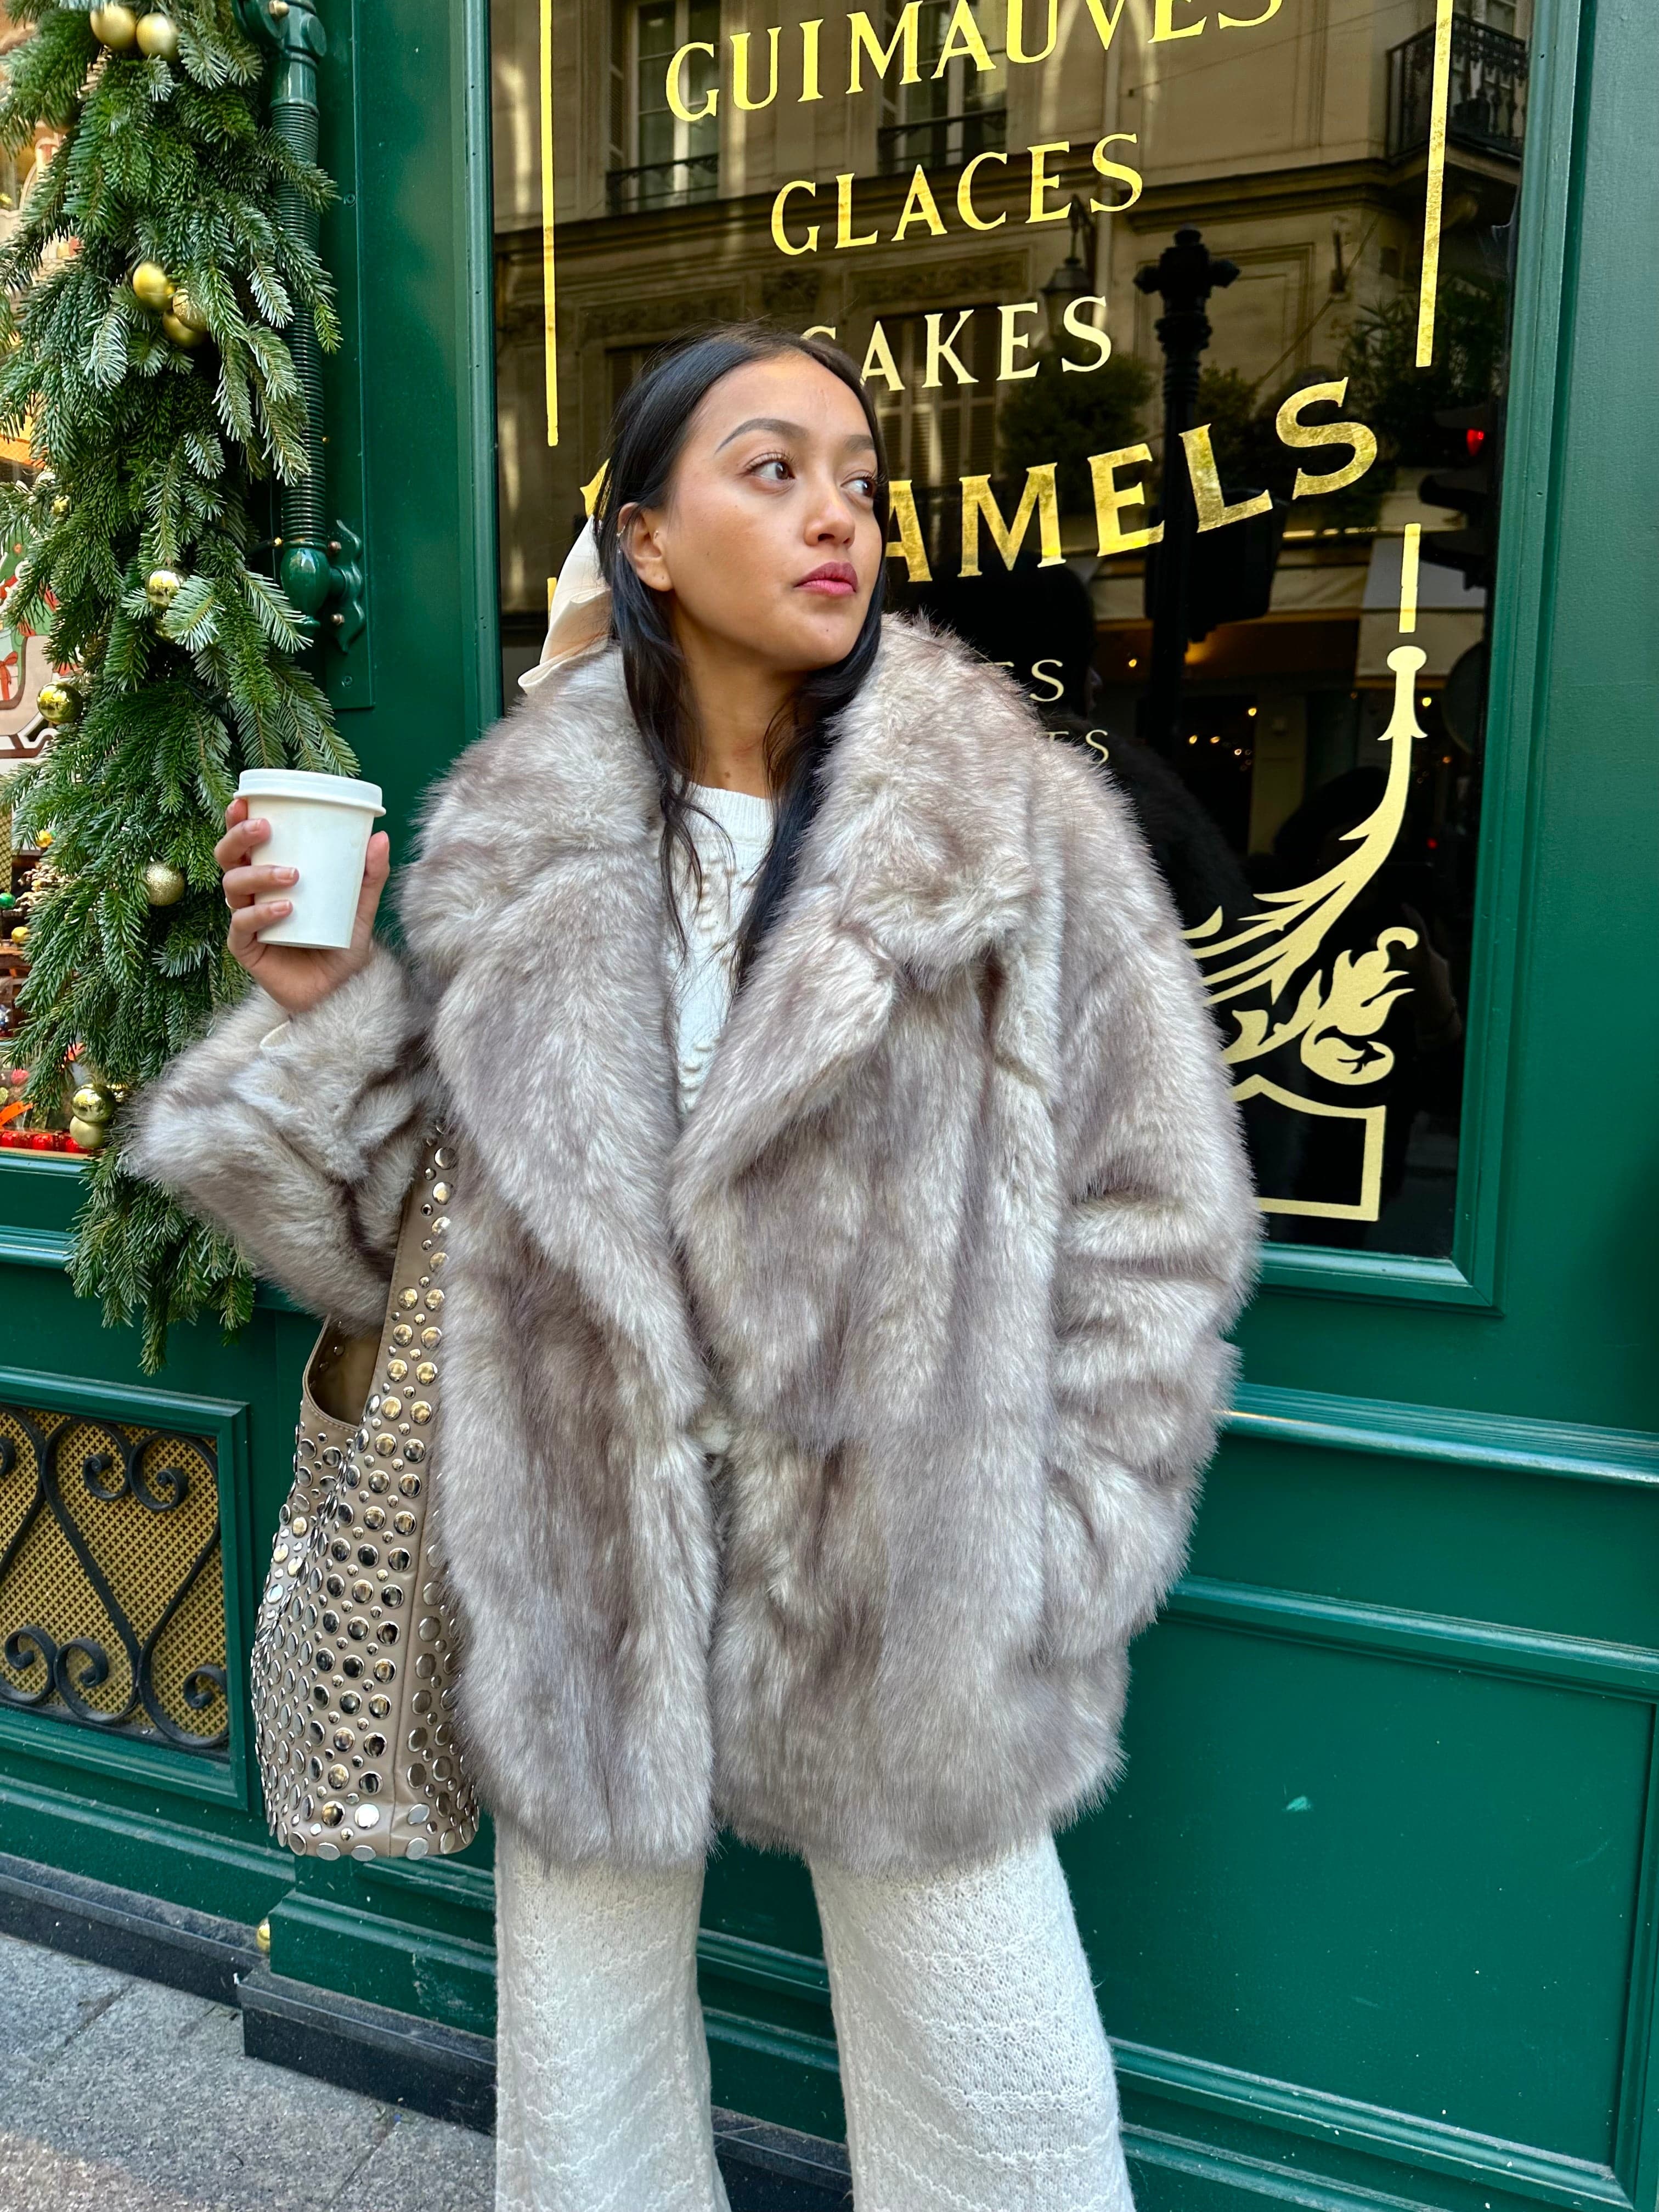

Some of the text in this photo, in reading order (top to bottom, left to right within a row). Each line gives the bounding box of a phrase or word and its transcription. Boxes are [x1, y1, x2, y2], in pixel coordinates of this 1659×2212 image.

[771, 133, 1143, 256] GLACES
[799, 296, 1111, 392] AKES
[580, 377, 1378, 581] AMELS
